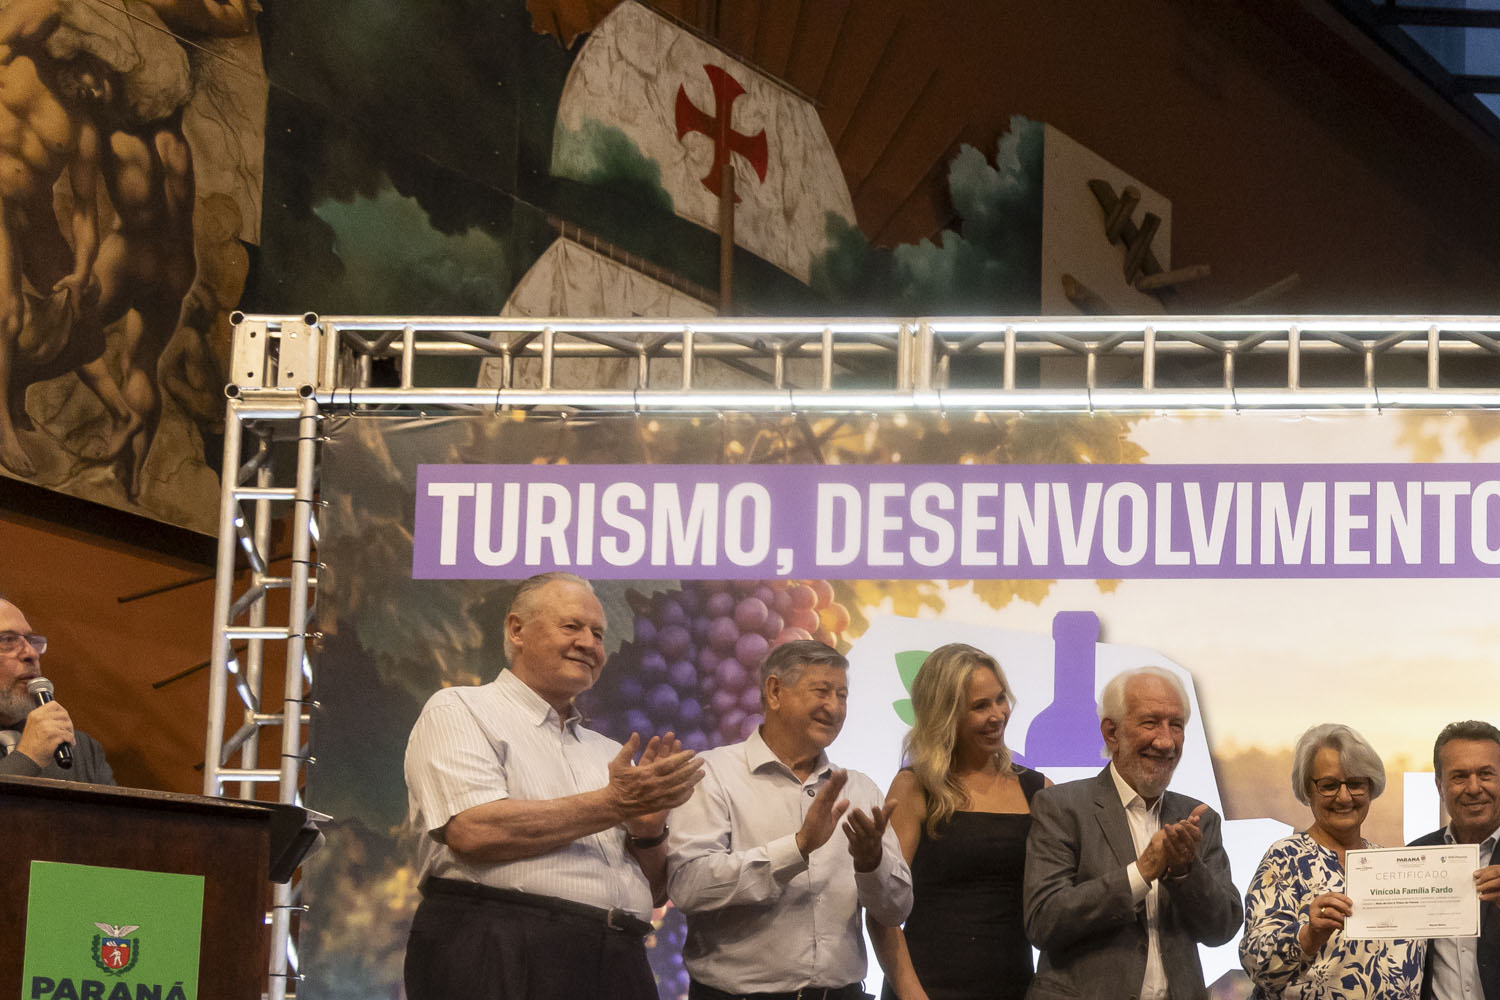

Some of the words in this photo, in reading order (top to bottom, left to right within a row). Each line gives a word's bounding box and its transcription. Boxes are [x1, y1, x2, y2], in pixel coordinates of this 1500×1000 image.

[428, 482, 793, 576] TURISMO,
[1375, 870, 1448, 881] CERTIFICADO
[1402, 887, 1430, 895] Família
[1431, 886, 1454, 894] Fardo
